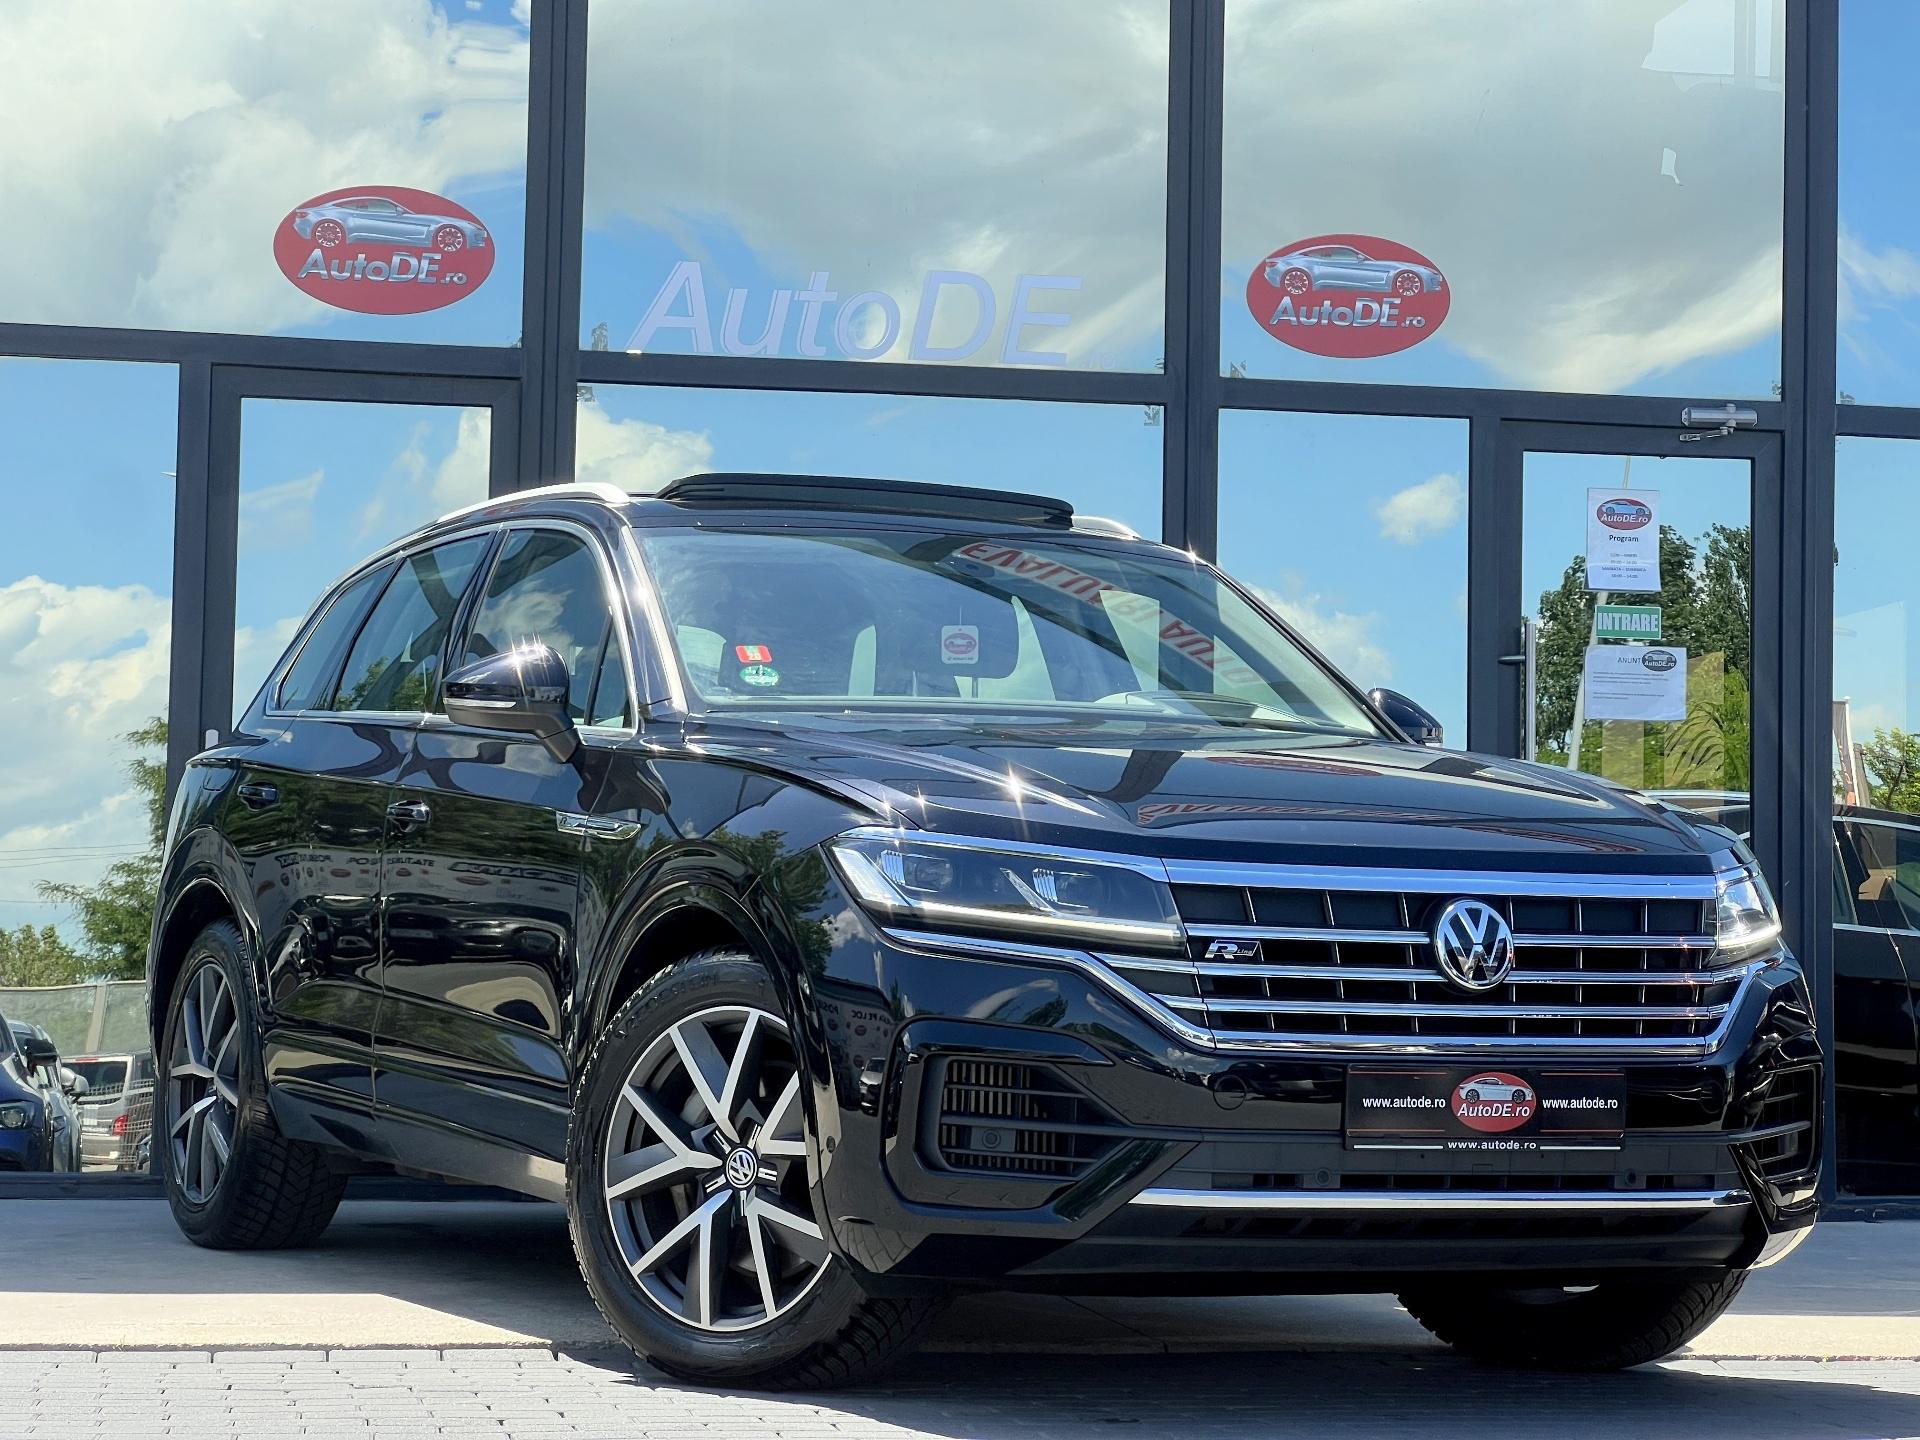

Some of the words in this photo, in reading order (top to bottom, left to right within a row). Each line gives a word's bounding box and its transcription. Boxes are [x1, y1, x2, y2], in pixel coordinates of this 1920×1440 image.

[1601, 513, 1648, 523] AutoDE.ro
[1609, 534, 1639, 543] Program
[1597, 612, 1659, 632] INTRARE
[1362, 1096, 1446, 1109] www.autode.ro
[1542, 1097, 1619, 1110] www.autode.ro
[1457, 1103, 1531, 1118] AutoDE.ro
[1447, 1139, 1537, 1150] www.autode.ro
